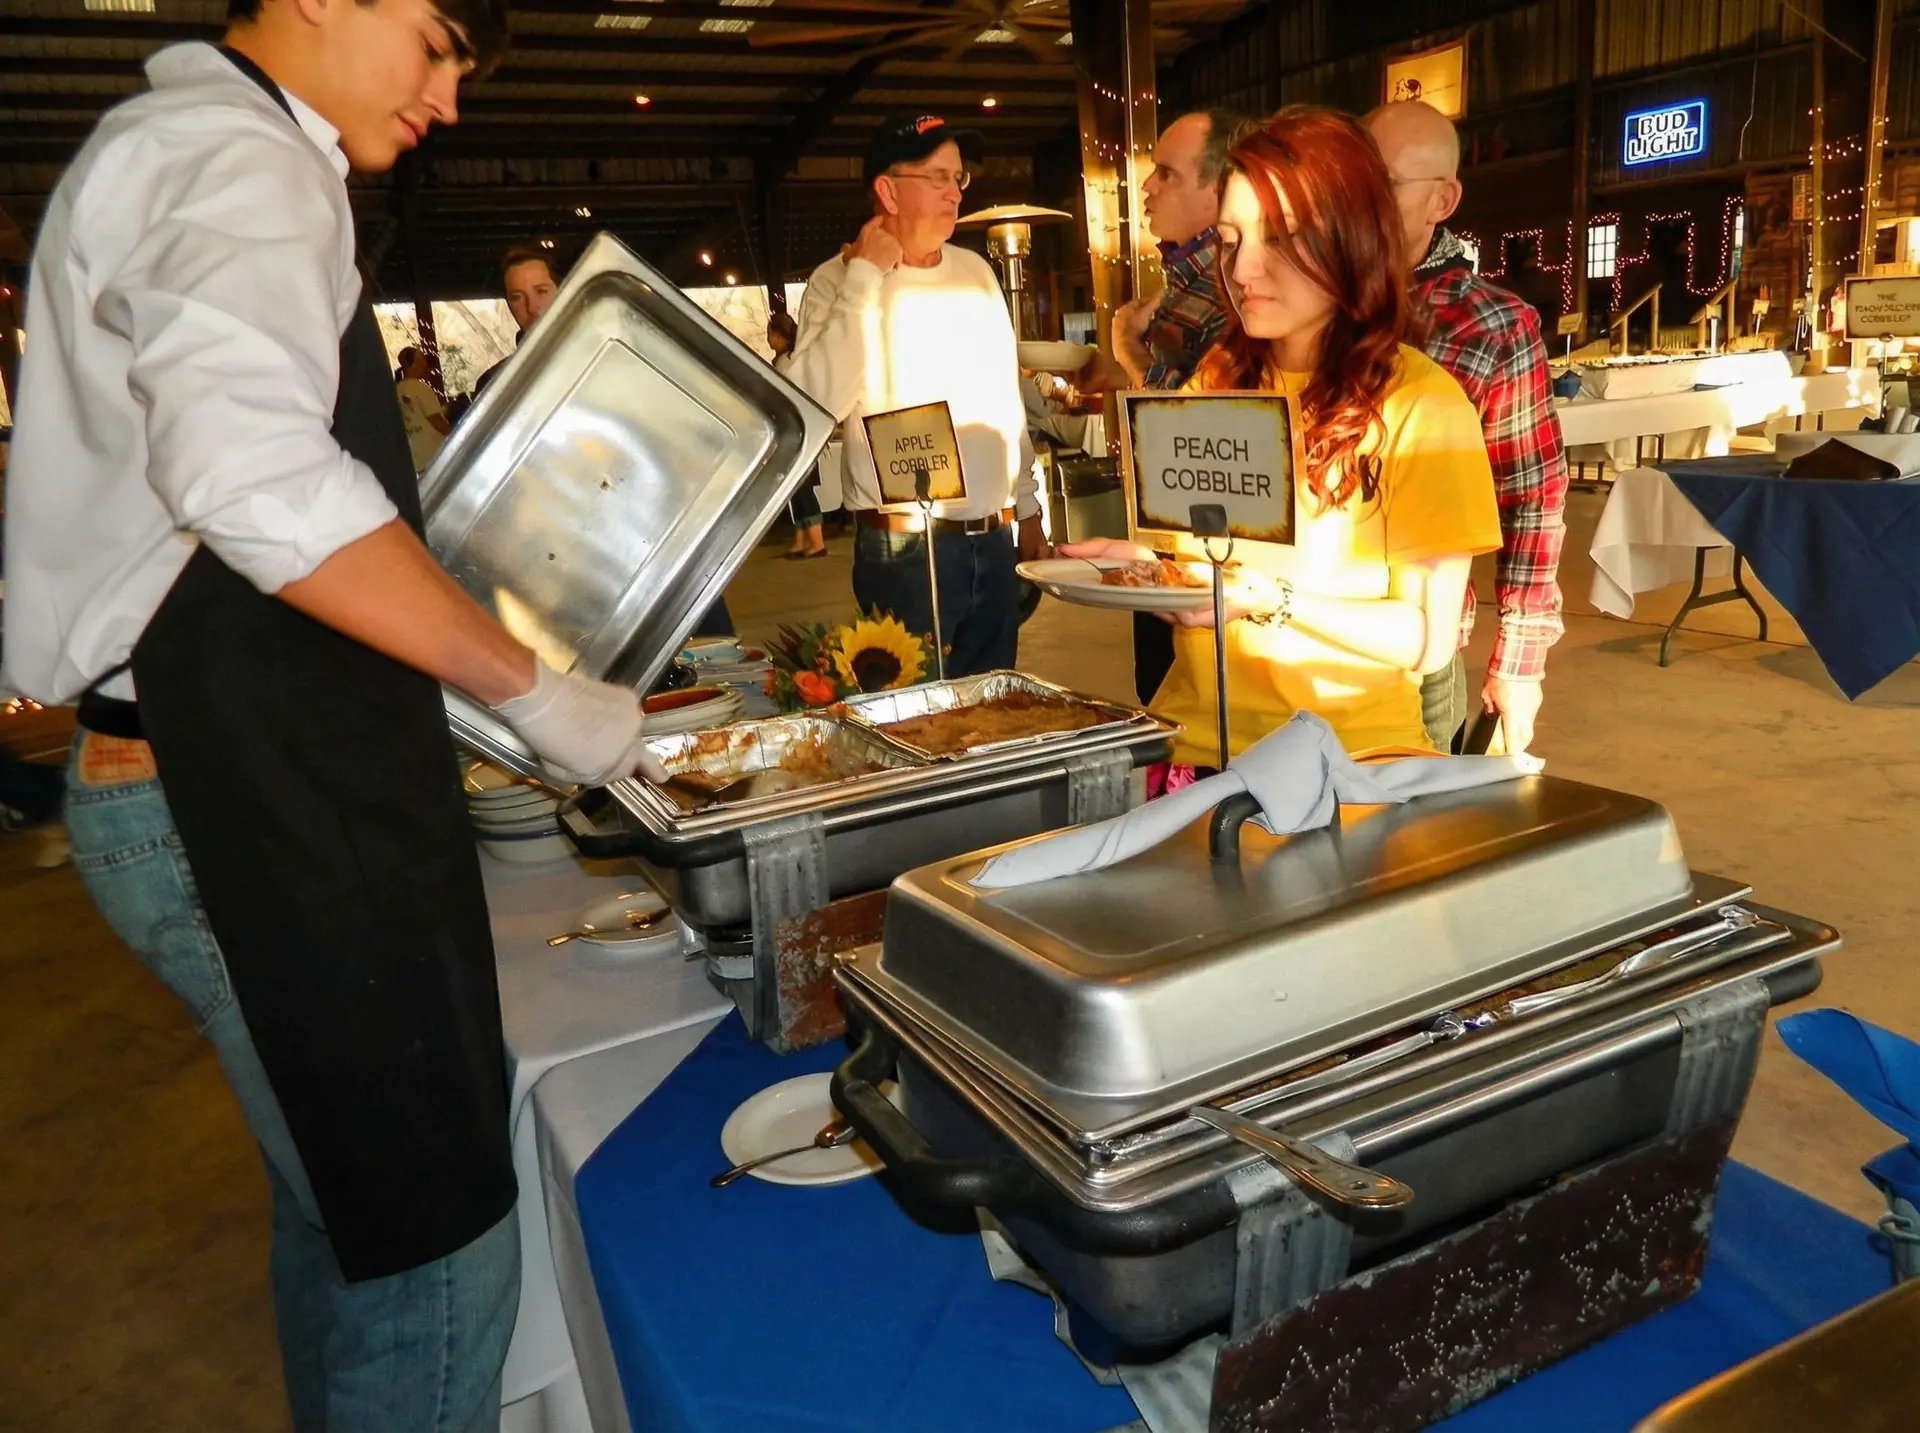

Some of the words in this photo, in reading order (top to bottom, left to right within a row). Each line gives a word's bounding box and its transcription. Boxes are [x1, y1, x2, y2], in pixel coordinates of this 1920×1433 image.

[1638, 110, 1688, 138] BUD
[1629, 127, 1698, 160] LIGHT
[894, 433, 935, 454] APPLE
[1173, 436, 1250, 463] PEACH
[889, 454, 950, 476] COBBLER
[1161, 467, 1272, 499] COBBLER
